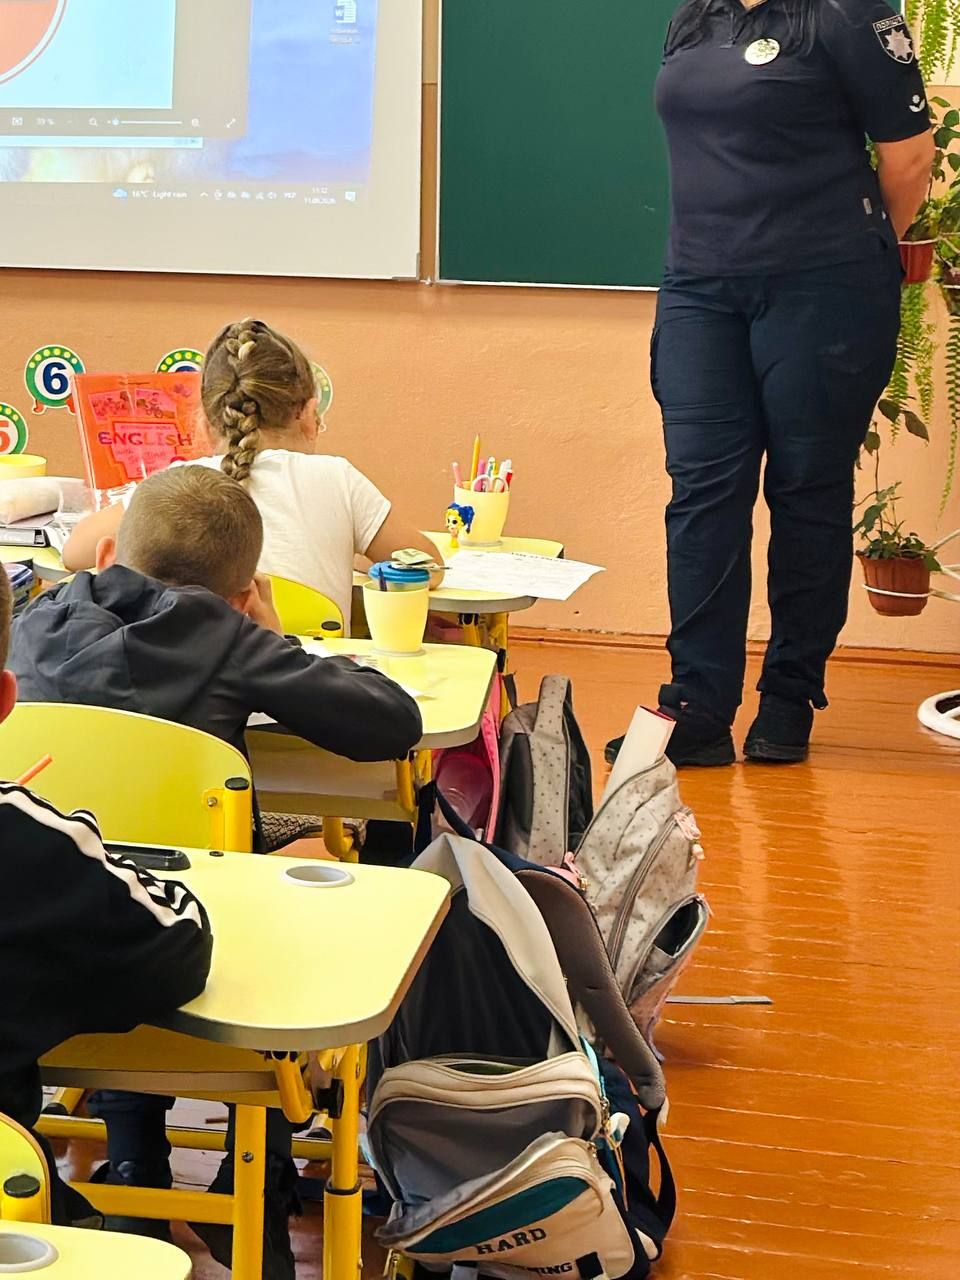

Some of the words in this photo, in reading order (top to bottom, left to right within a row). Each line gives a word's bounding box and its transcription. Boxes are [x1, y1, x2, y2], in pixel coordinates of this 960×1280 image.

[42, 361, 69, 395] 6
[98, 431, 192, 447] ENGLISH
[475, 1227, 547, 1255] HARD
